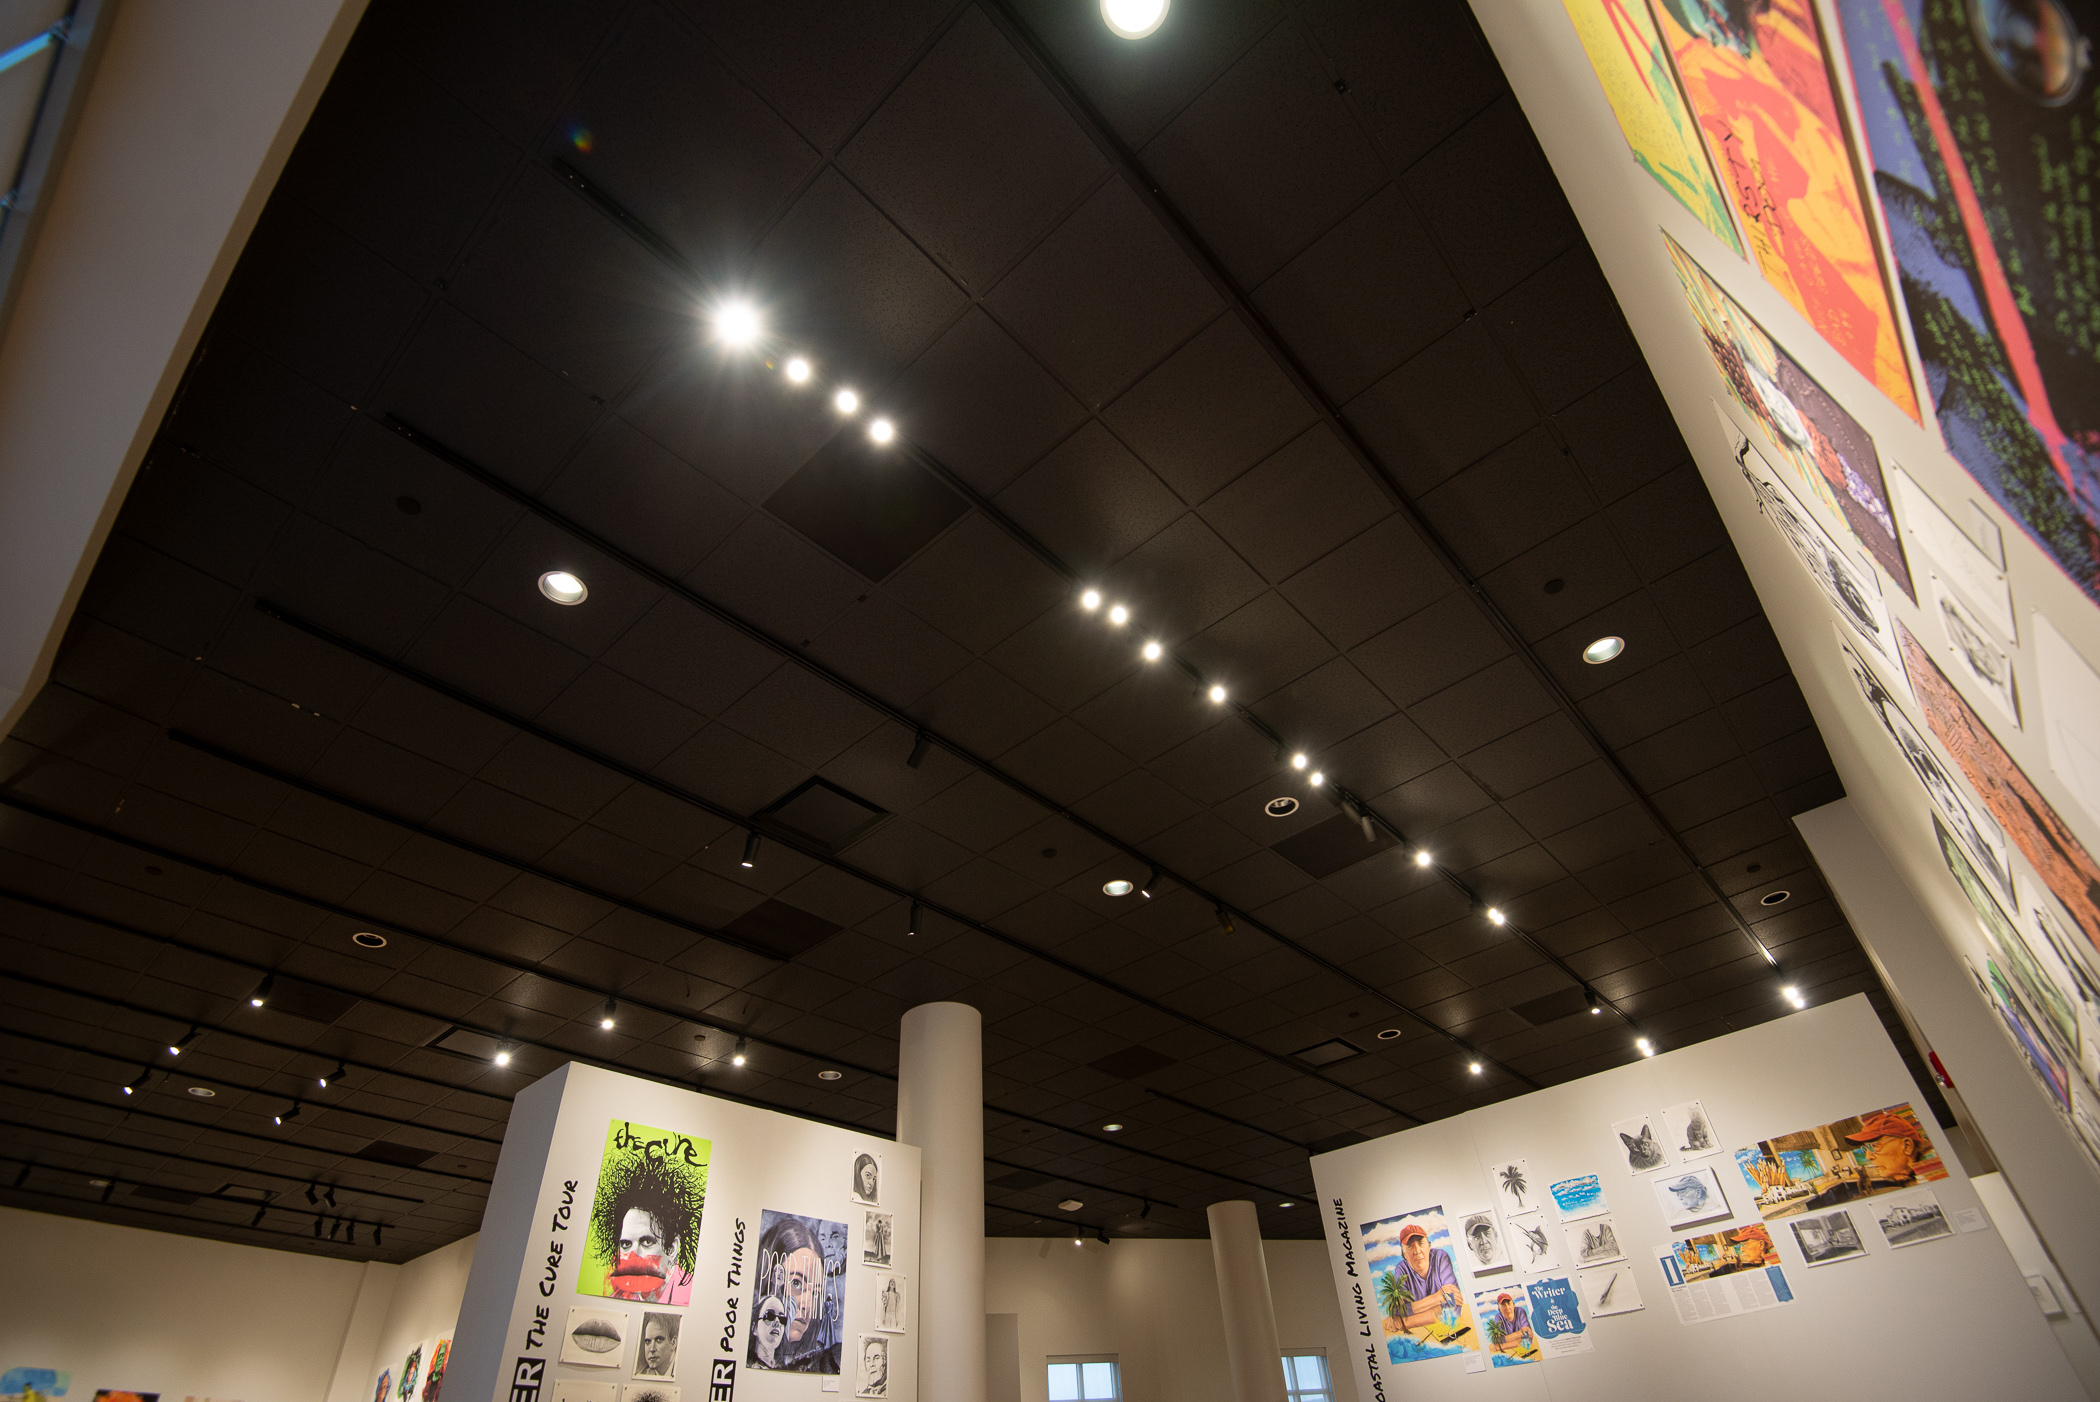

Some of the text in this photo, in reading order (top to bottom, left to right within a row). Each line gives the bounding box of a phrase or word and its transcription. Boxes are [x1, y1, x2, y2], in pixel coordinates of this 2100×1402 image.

[727, 1217, 746, 1289] THINGS
[1333, 1197, 1359, 1277] MAGAZINE
[525, 1304, 550, 1351] THE
[538, 1240, 564, 1297] CURE
[551, 1179, 579, 1233] TOUR
[1531, 1286, 1566, 1299] Writer
[720, 1297, 739, 1353] POOR
[1352, 1282, 1372, 1337] LIVING
[1546, 1318, 1574, 1333] Sea
[1547, 1308, 1564, 1316] Deep
